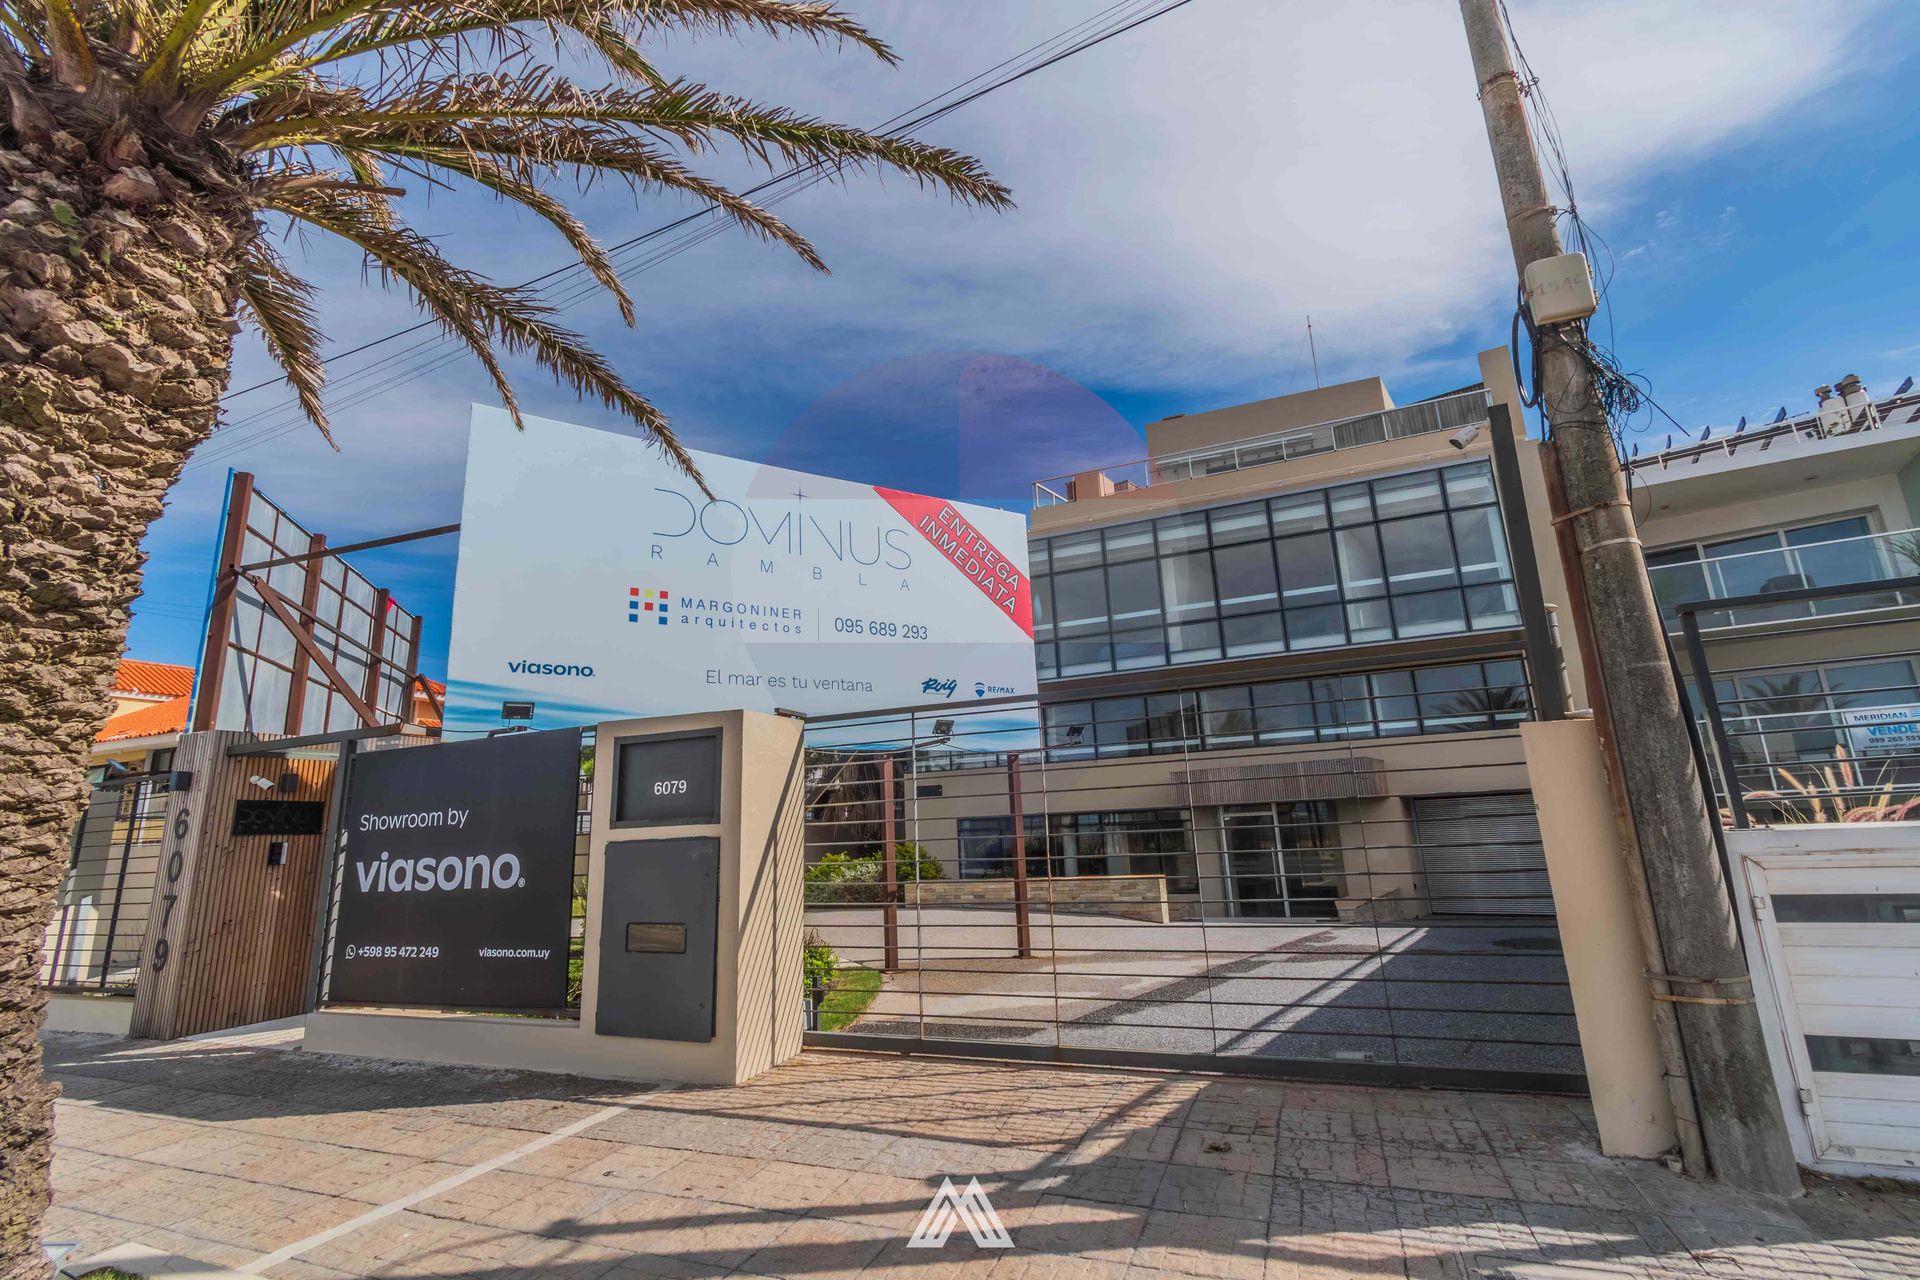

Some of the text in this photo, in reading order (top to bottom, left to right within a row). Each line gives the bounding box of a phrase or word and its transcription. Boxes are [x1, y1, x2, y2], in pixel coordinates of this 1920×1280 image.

[653, 487, 912, 570] DOMINUS
[938, 506, 1020, 591] ENTREGA
[651, 544, 910, 592] RAMBLA
[919, 515, 1016, 614] INMEDIATA
[681, 597, 802, 620] MARGONINER
[681, 615, 802, 634] arquitectos
[834, 617, 928, 640] 095 689 293
[706, 669, 873, 693] El mar es tu ventana
[922, 678, 957, 698] Roig
[987, 685, 1015, 694] RE/MAX
[1853, 711, 1908, 721] MERIDIAN
[1867, 724, 1919, 736] VENDE
[654, 780, 687, 795] 6079
[360, 807, 469, 831] Showroom by
[152, 808, 190, 973] 6079
[357, 946, 439, 959] +598 95 472 249
[479, 947, 551, 960] viasono.com.uy
